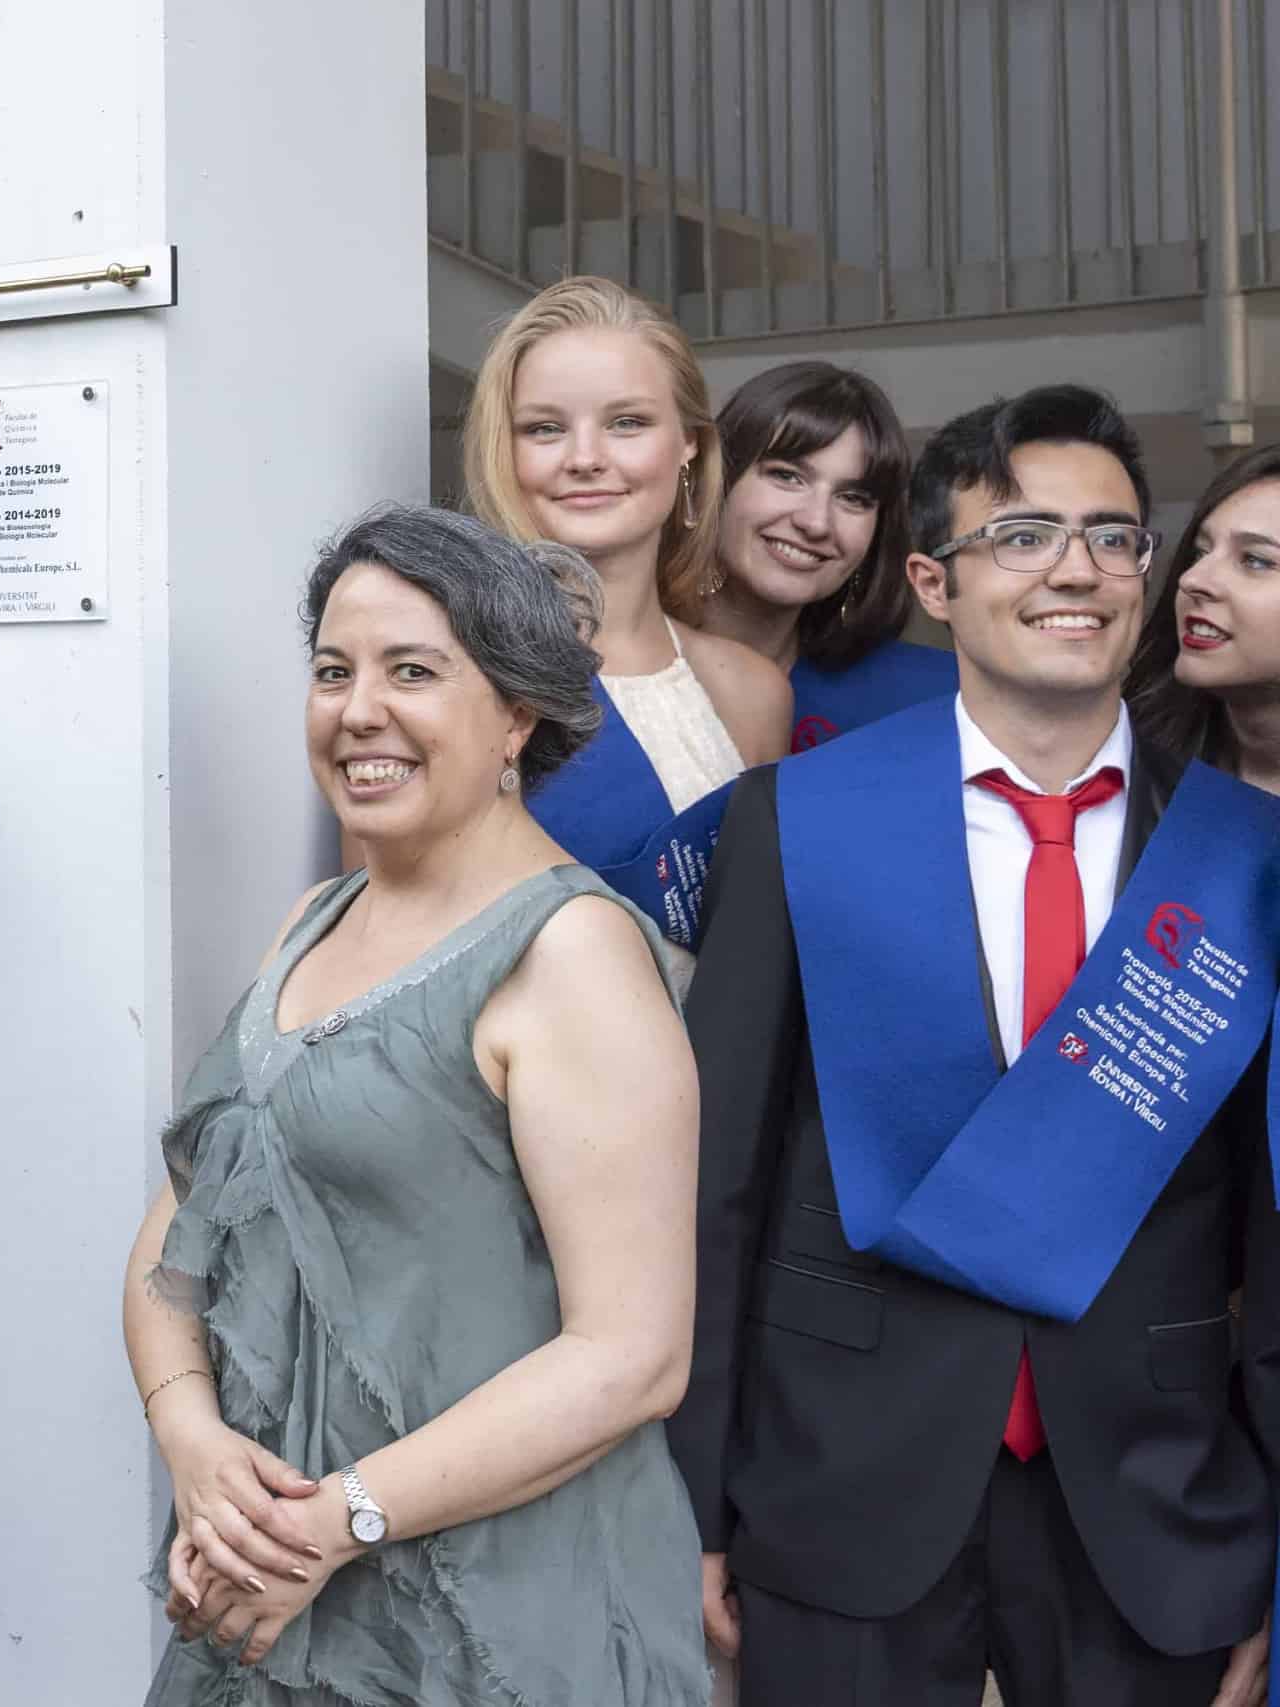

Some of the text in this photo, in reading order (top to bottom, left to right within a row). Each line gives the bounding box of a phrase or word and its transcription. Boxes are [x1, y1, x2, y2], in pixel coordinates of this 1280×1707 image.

[4, 463, 61, 476] 2015-2019
[4, 507, 61, 521] 2014-2019
[1121, 947, 1229, 1030] Promoció 2015-2019
[1076, 1007, 1127, 1053] Chemicals
[1127, 1049, 1167, 1087] Europe,
[1095, 1003, 1189, 1081] Sekisui Specialty
[1114, 1001, 1167, 1047] Apadrinada
[1161, 1008, 1207, 1045] Molecular
[1088, 1064, 1127, 1102] ROVIRA
[1097, 1053, 1160, 1107] UNIVERSITAT
